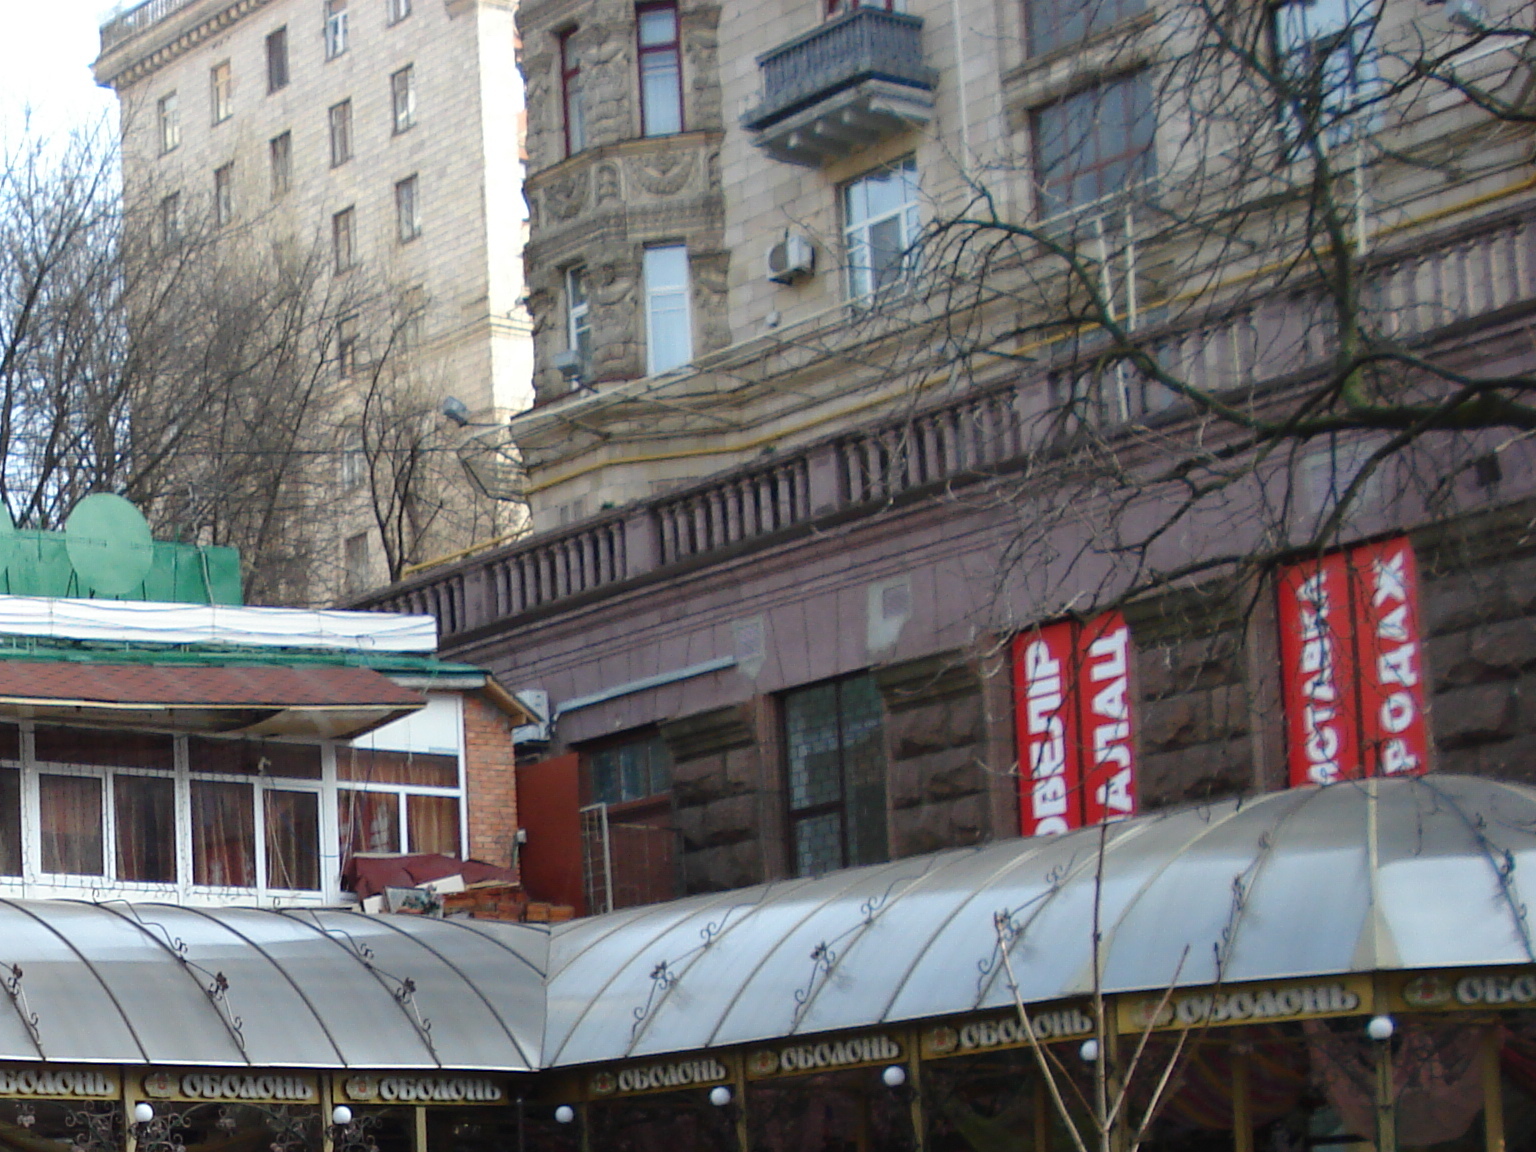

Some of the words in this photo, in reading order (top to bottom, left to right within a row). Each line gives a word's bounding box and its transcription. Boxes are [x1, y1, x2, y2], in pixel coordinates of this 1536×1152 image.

[781, 1035, 901, 1072] ОБОЛОНЬ
[182, 1073, 314, 1100] ОБОЛОНЬ
[378, 1076, 502, 1102] ОБОЛОНЬ
[618, 1059, 727, 1091] ОБОЛОНЬ
